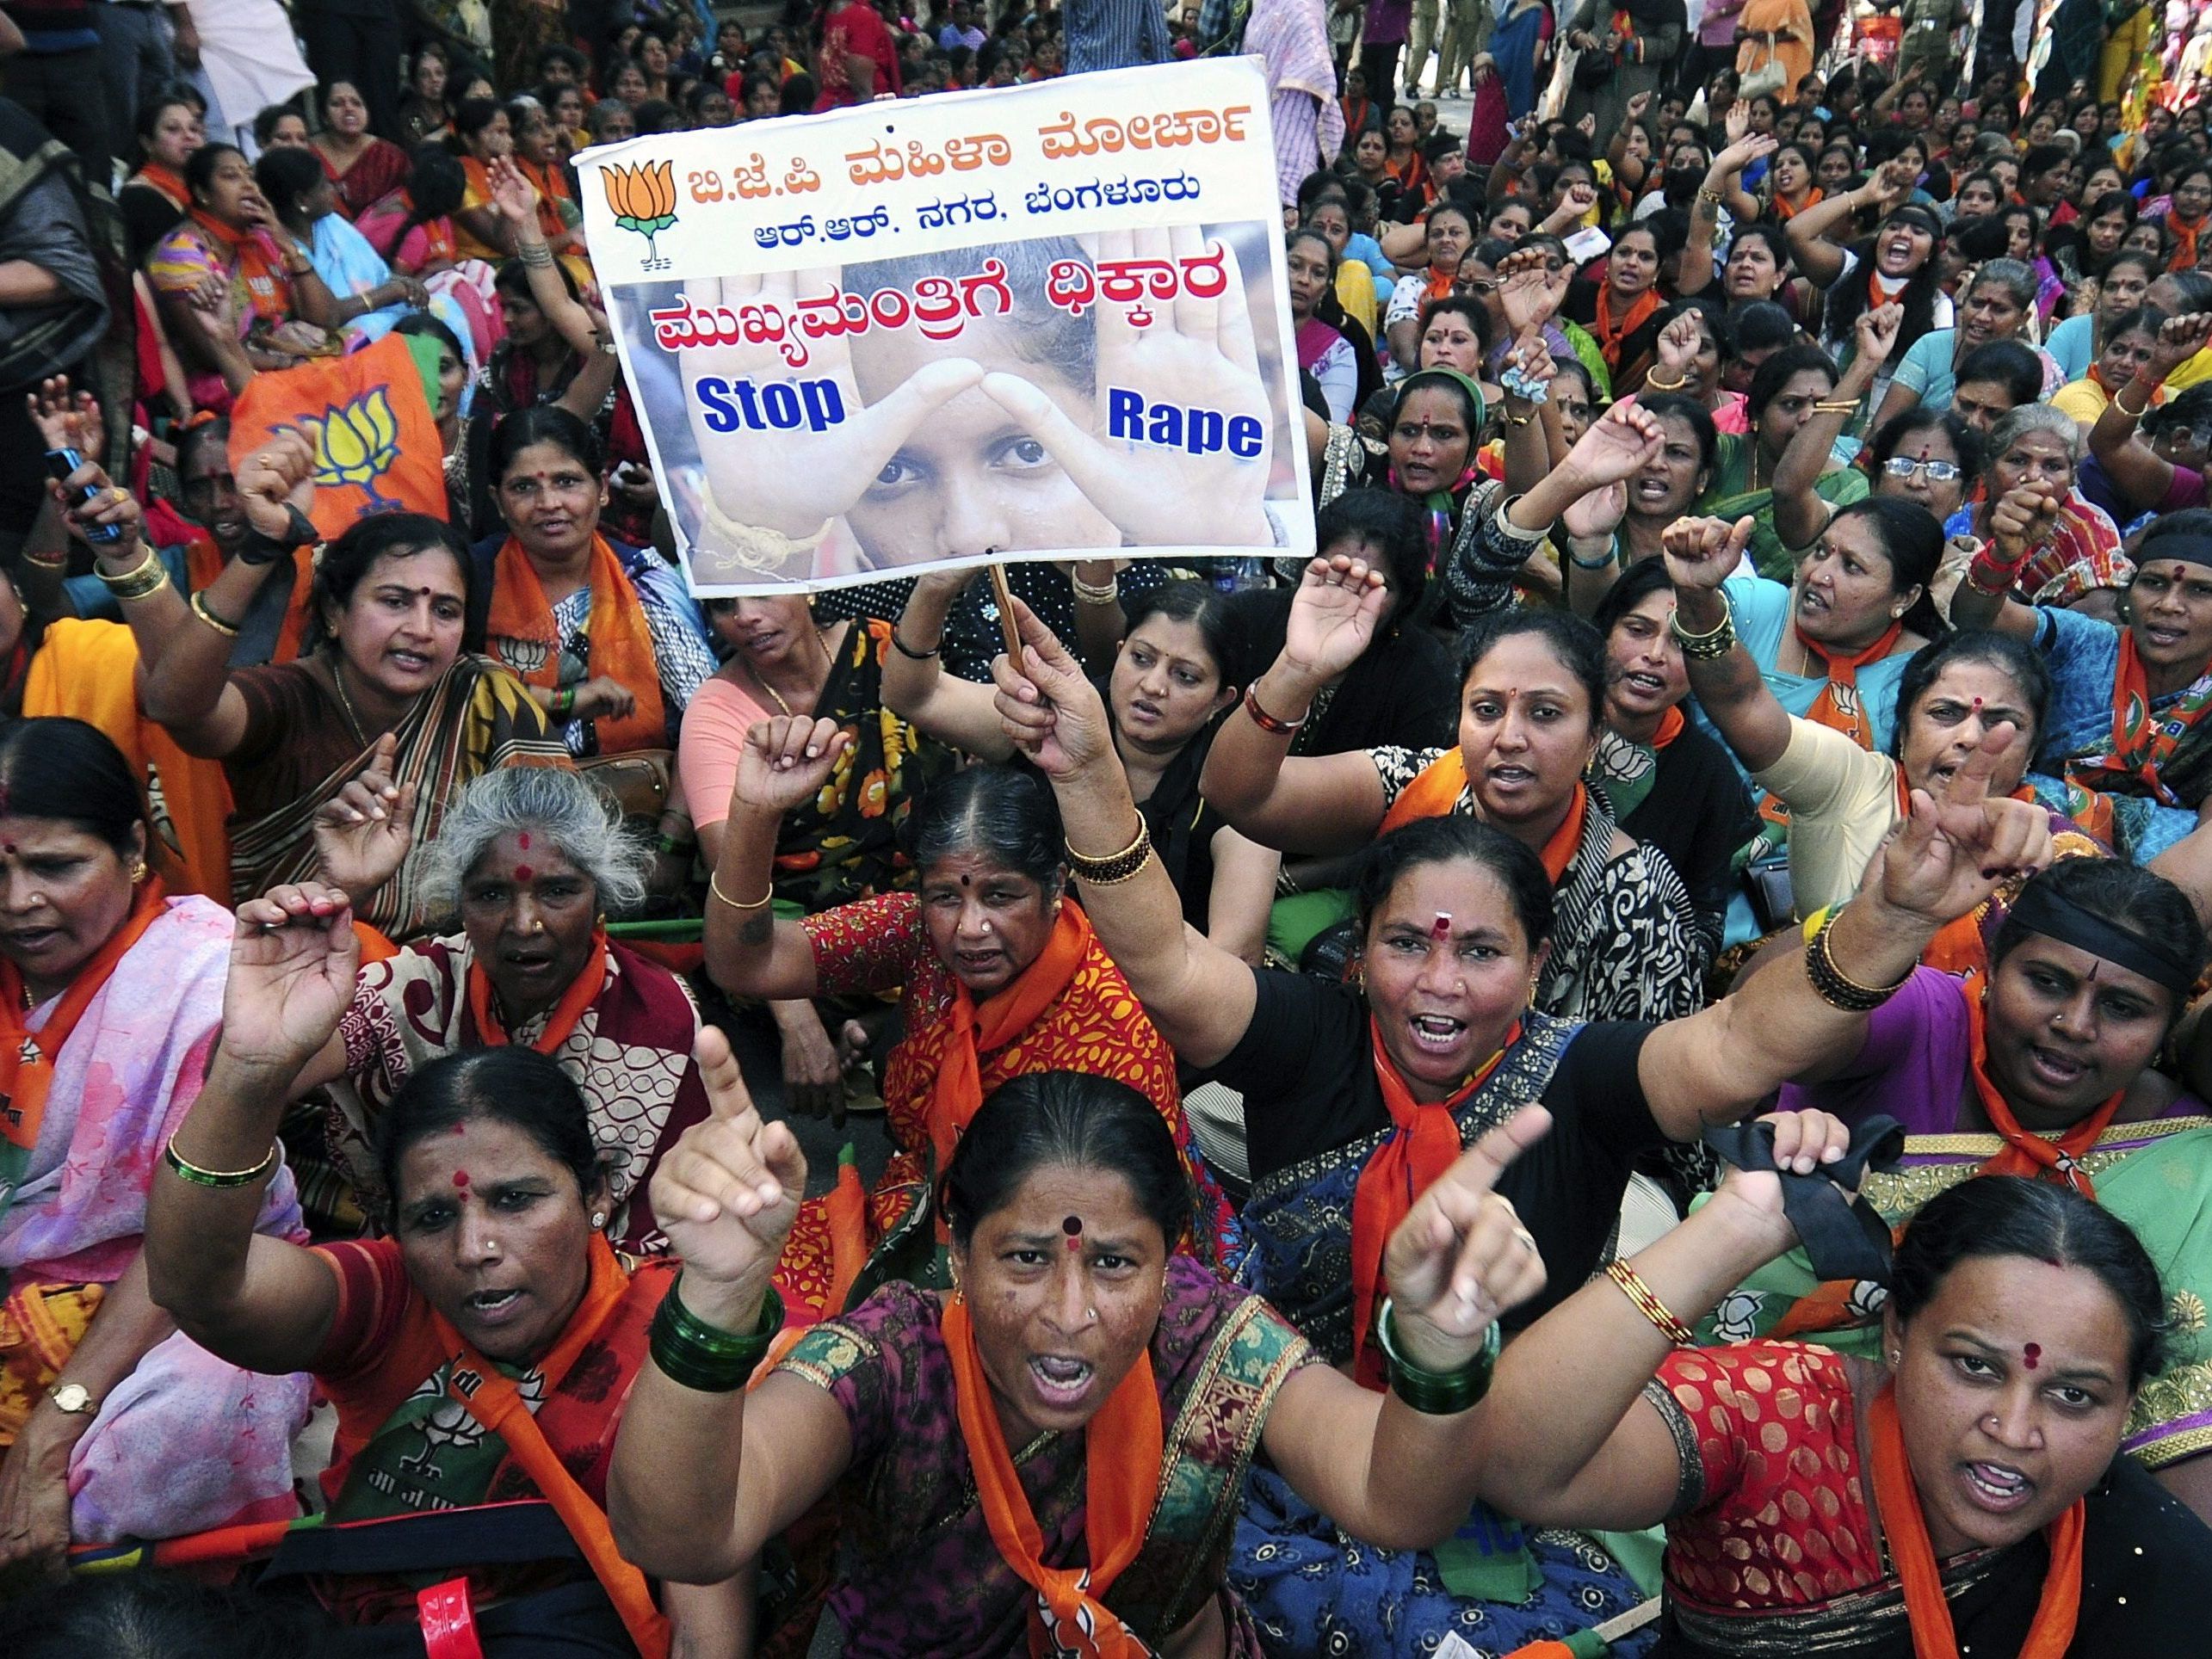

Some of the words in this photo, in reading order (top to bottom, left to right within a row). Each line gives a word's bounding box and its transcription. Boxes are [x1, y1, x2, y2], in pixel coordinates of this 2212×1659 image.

[688, 153, 820, 204] ಬಿ.ಜೆ.ಪಿ
[844, 133, 1012, 187] ಮಹಿಳಾ
[1038, 105, 1251, 159] ಮೋರ್ಚಾ
[1024, 169, 1201, 214] ಬೆಂಗಳೂರು
[652, 259, 1012, 367] ಮುಖ್ಯಮಂತ್ರಿಗೆ
[1047, 240, 1227, 327] ಧಿಕ್ಕಾರ
[695, 378, 845, 432] Stop
[1109, 388, 1263, 458] Rape
